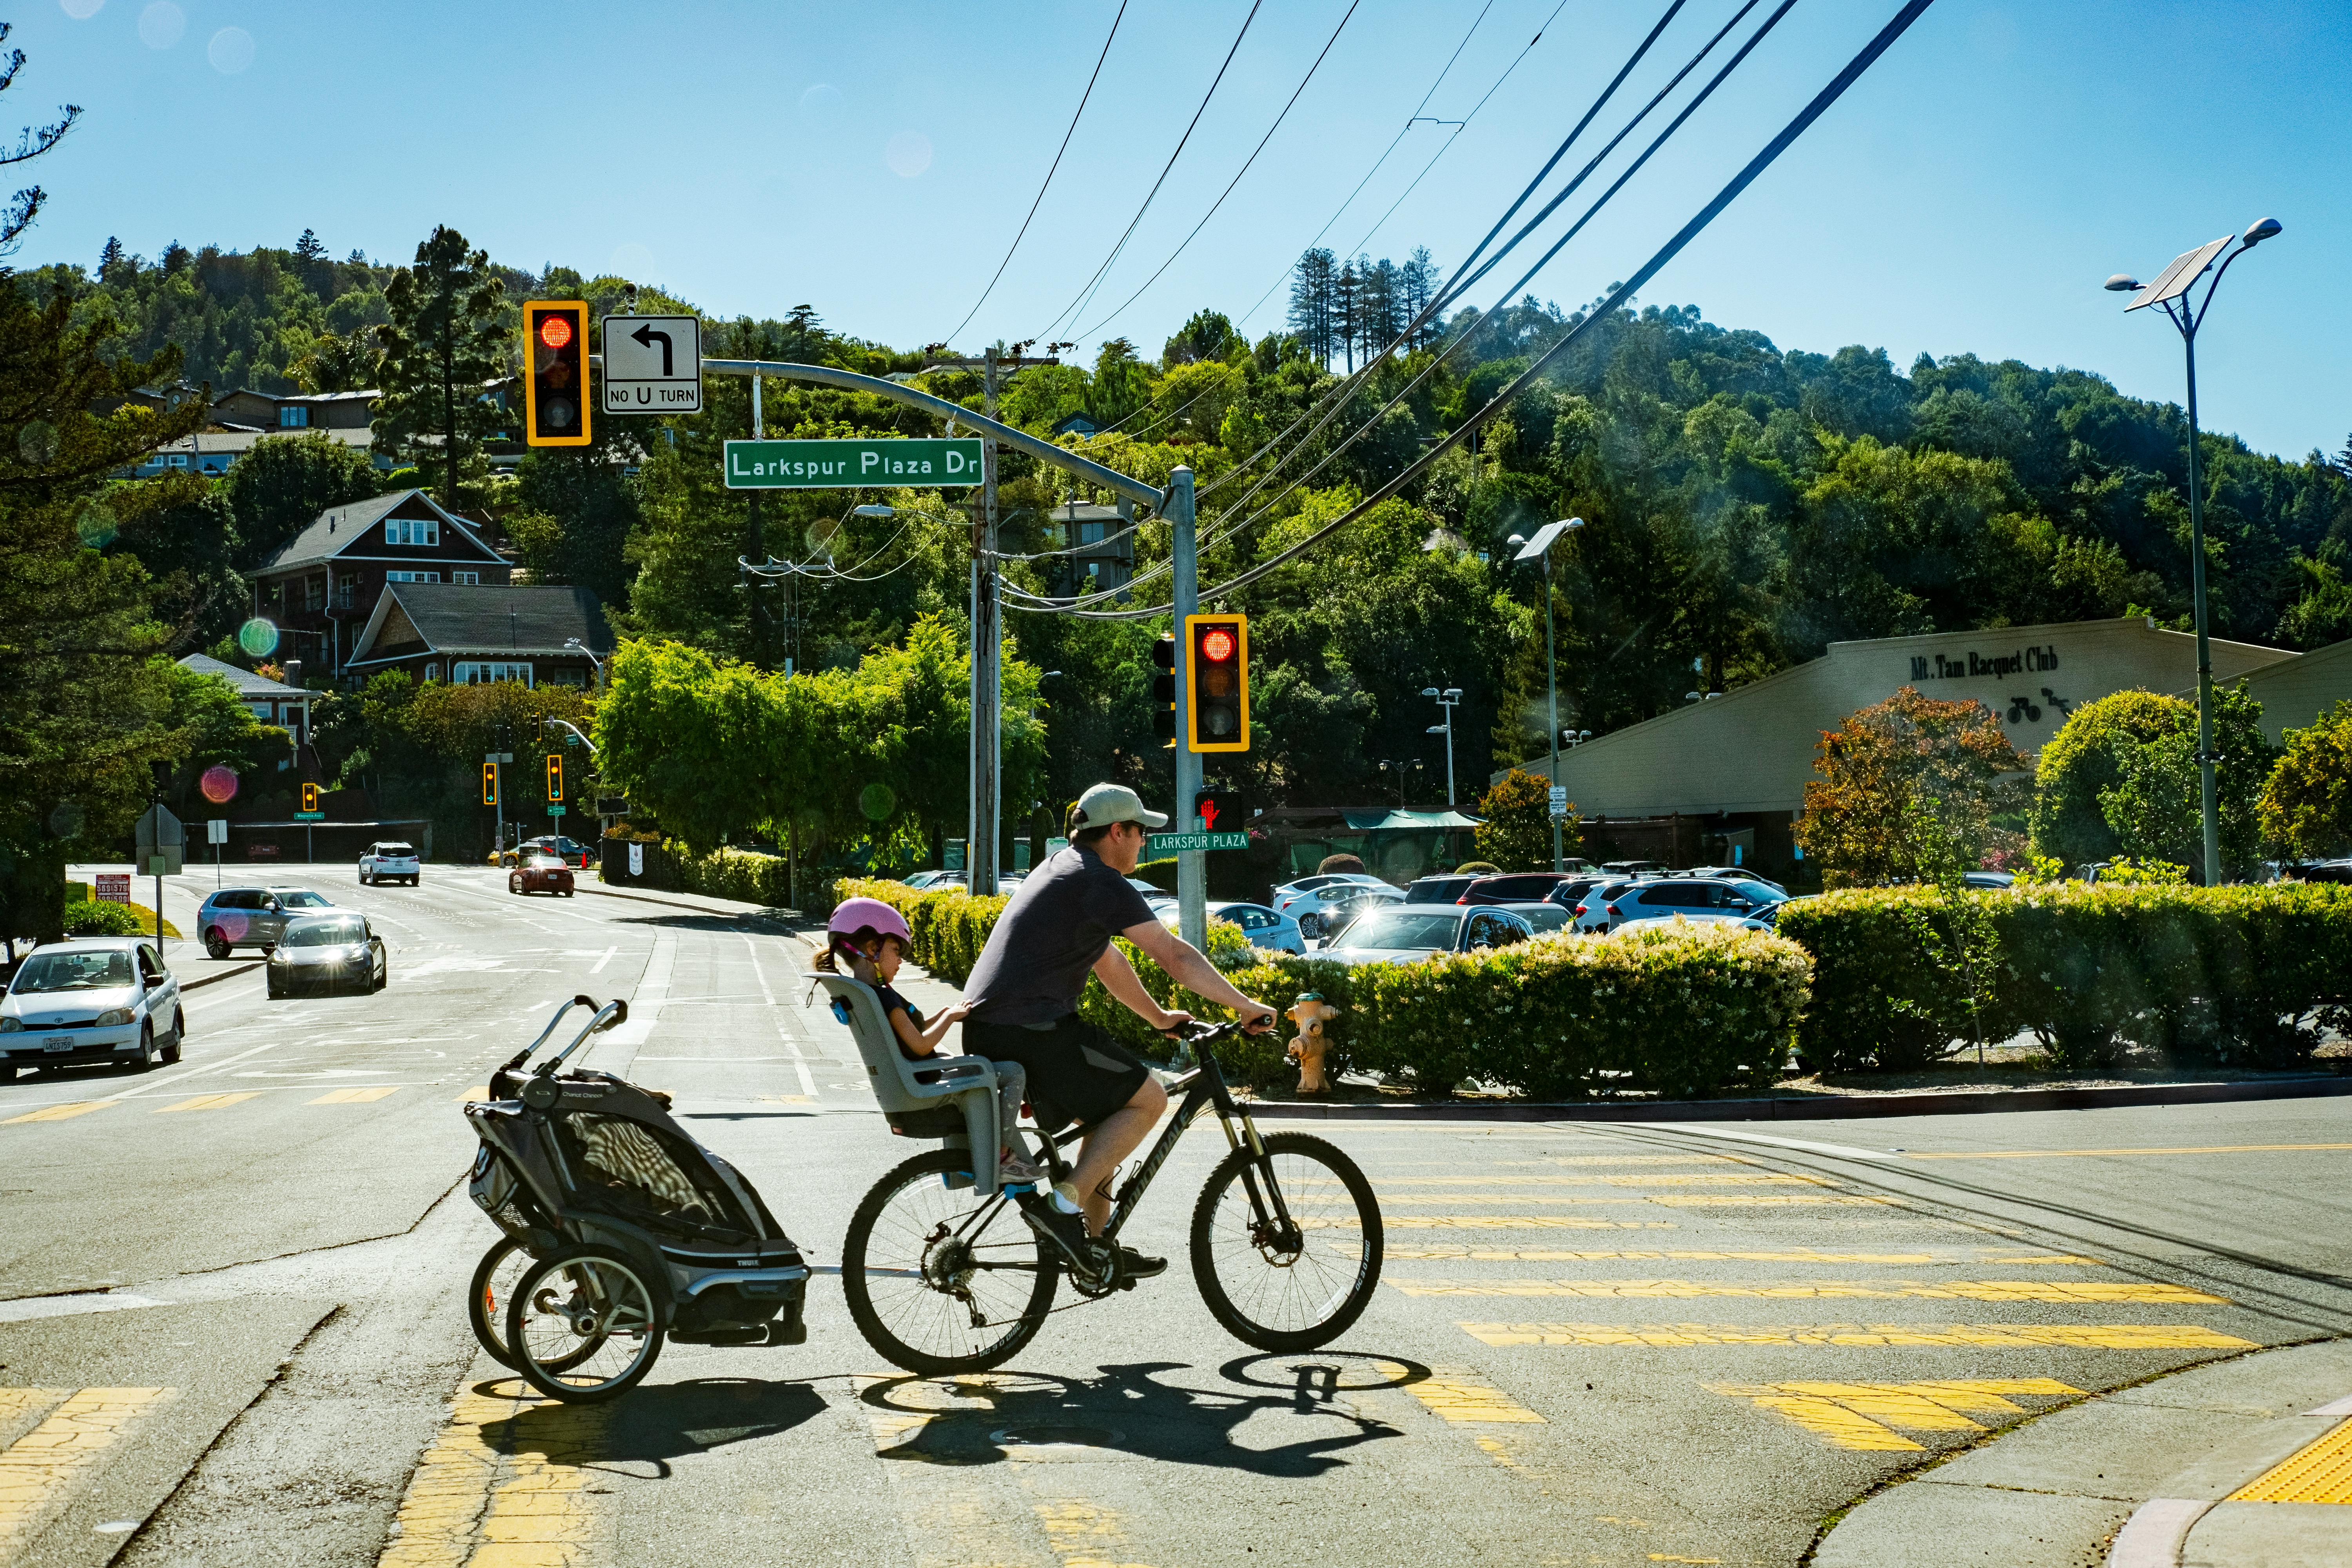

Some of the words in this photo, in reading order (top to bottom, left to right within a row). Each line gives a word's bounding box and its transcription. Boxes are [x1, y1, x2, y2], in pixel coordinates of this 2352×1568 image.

[611, 390, 628, 402] NO
[637, 387, 651, 405] U
[659, 390, 694, 402] TURN
[733, 453, 846, 479] Larkspur
[861, 452, 931, 474] Plaza
[946, 451, 977, 473] Dr
[1935, 654, 1965, 679] Tam
[1968, 650, 2024, 680] Racquet
[2025, 645, 2059, 672] Club
[1154, 836, 1208, 849] LARKSPUR
[1213, 835, 1246, 847] PLAZA
